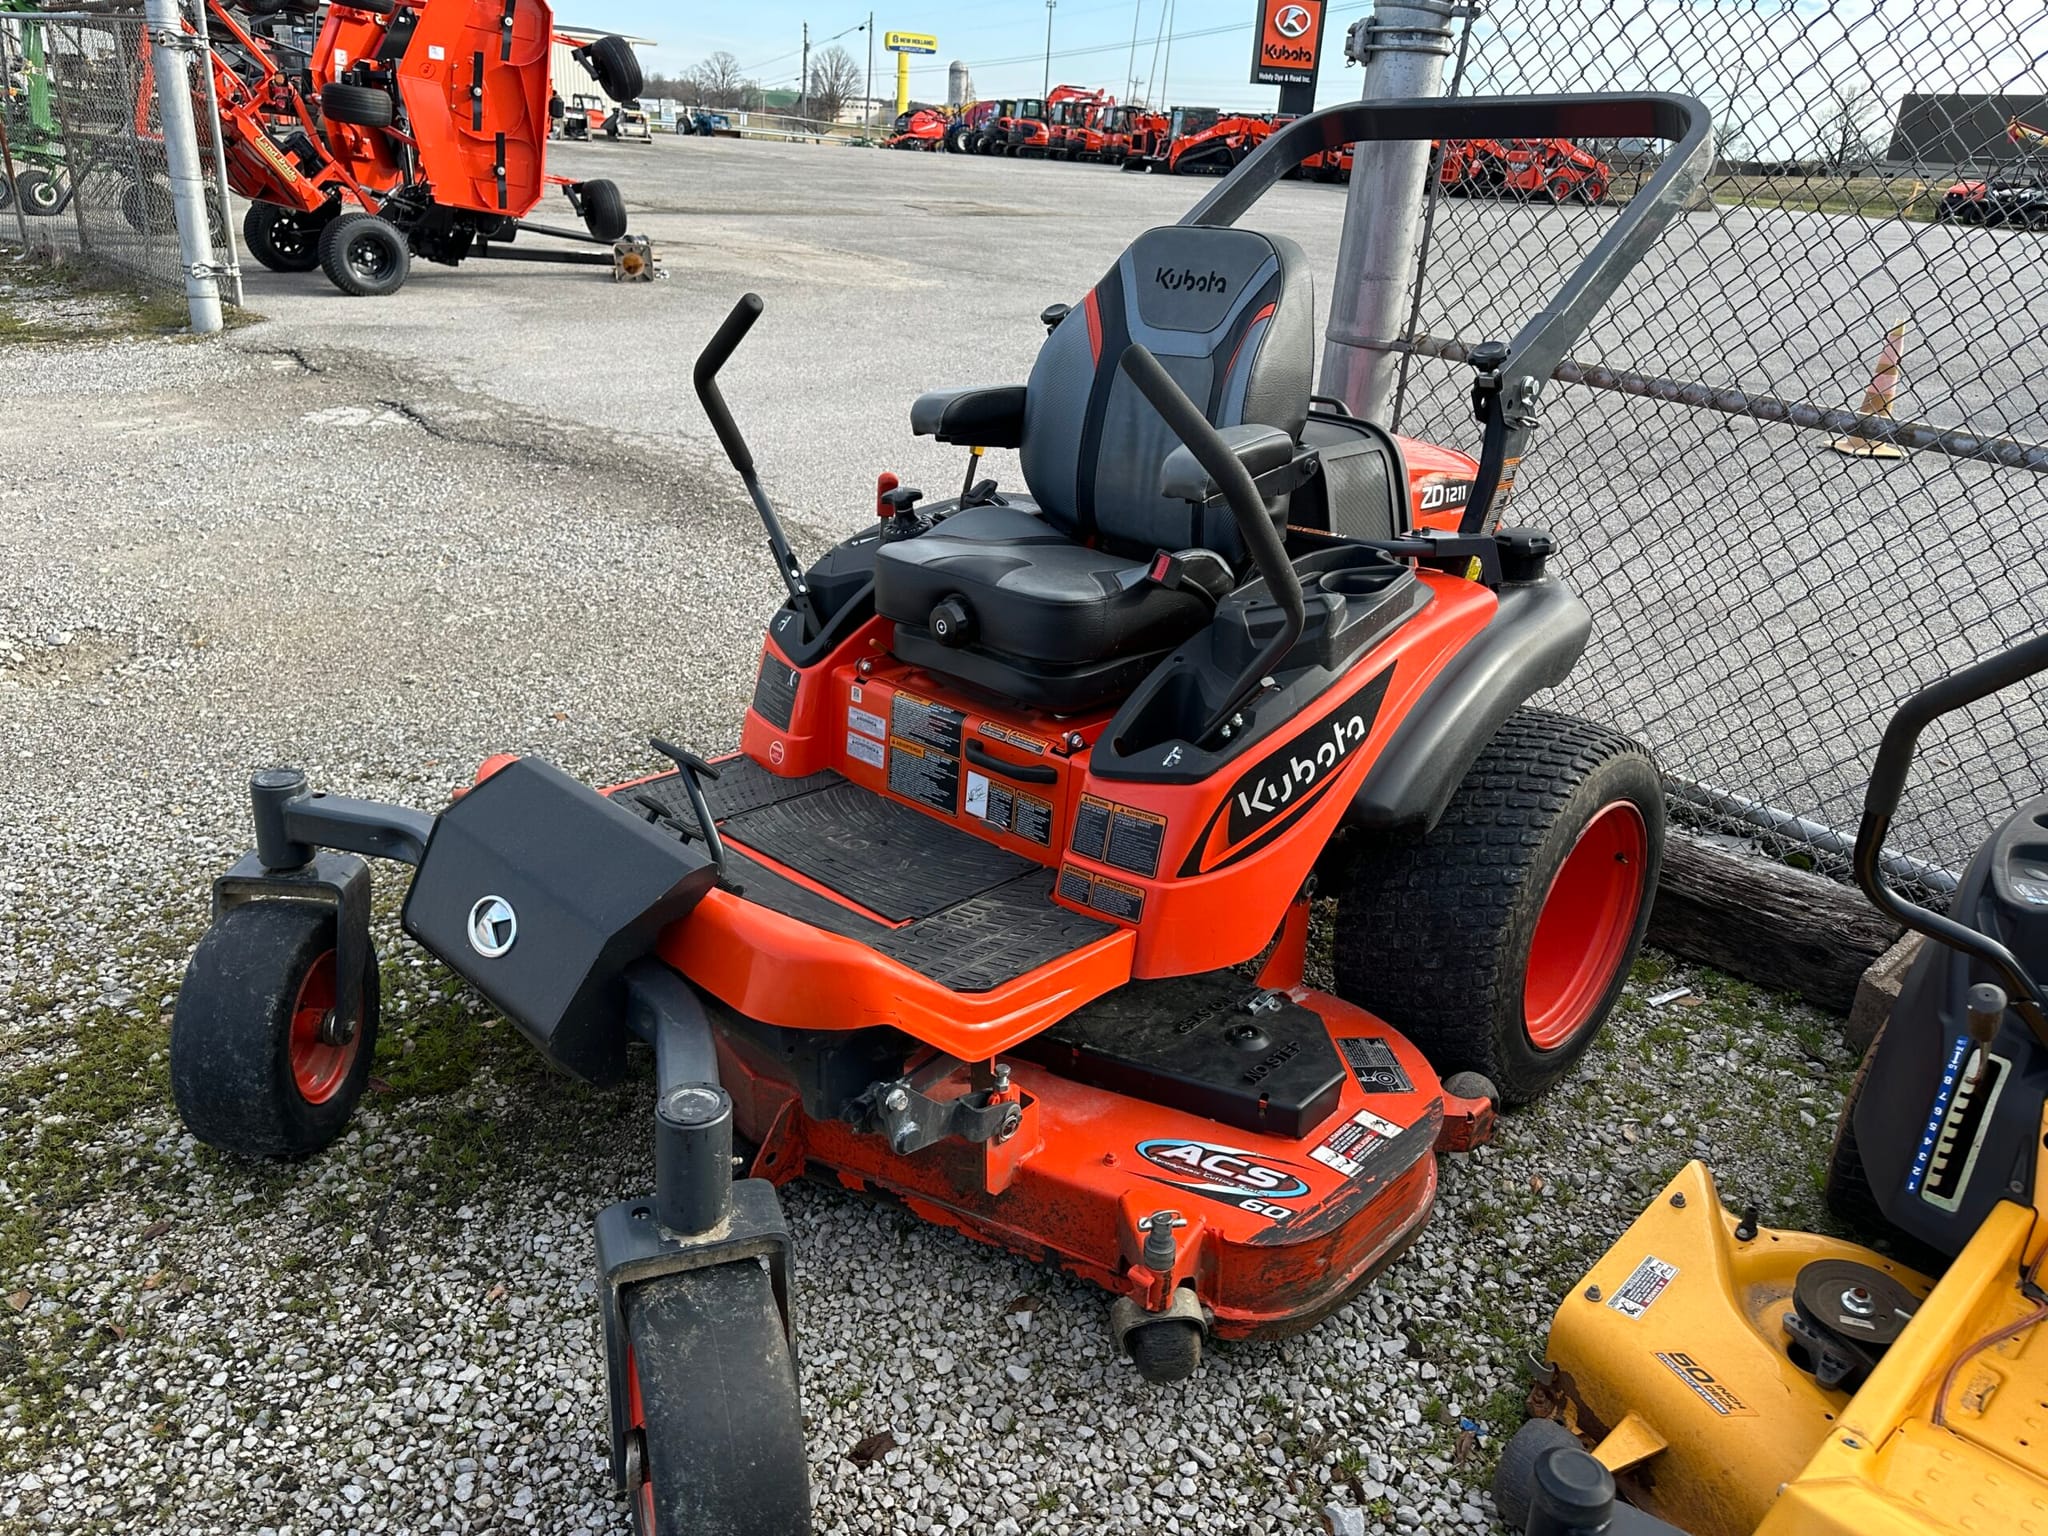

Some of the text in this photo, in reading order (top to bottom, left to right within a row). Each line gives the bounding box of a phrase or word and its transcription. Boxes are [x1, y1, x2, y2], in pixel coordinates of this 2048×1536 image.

[1265, 43, 1312, 62] Kubota
[1155, 267, 1227, 293] Kubota
[1238, 715, 1366, 817] Kubota
[1244, 1061, 1271, 1087] NO
[1266, 1039, 1302, 1070] STEP
[1157, 1144, 1289, 1189] ACS
[1238, 1198, 1293, 1220] 60
[1667, 1352, 1747, 1410] 50 INCH
[1704, 1385, 1738, 1411] DECK
